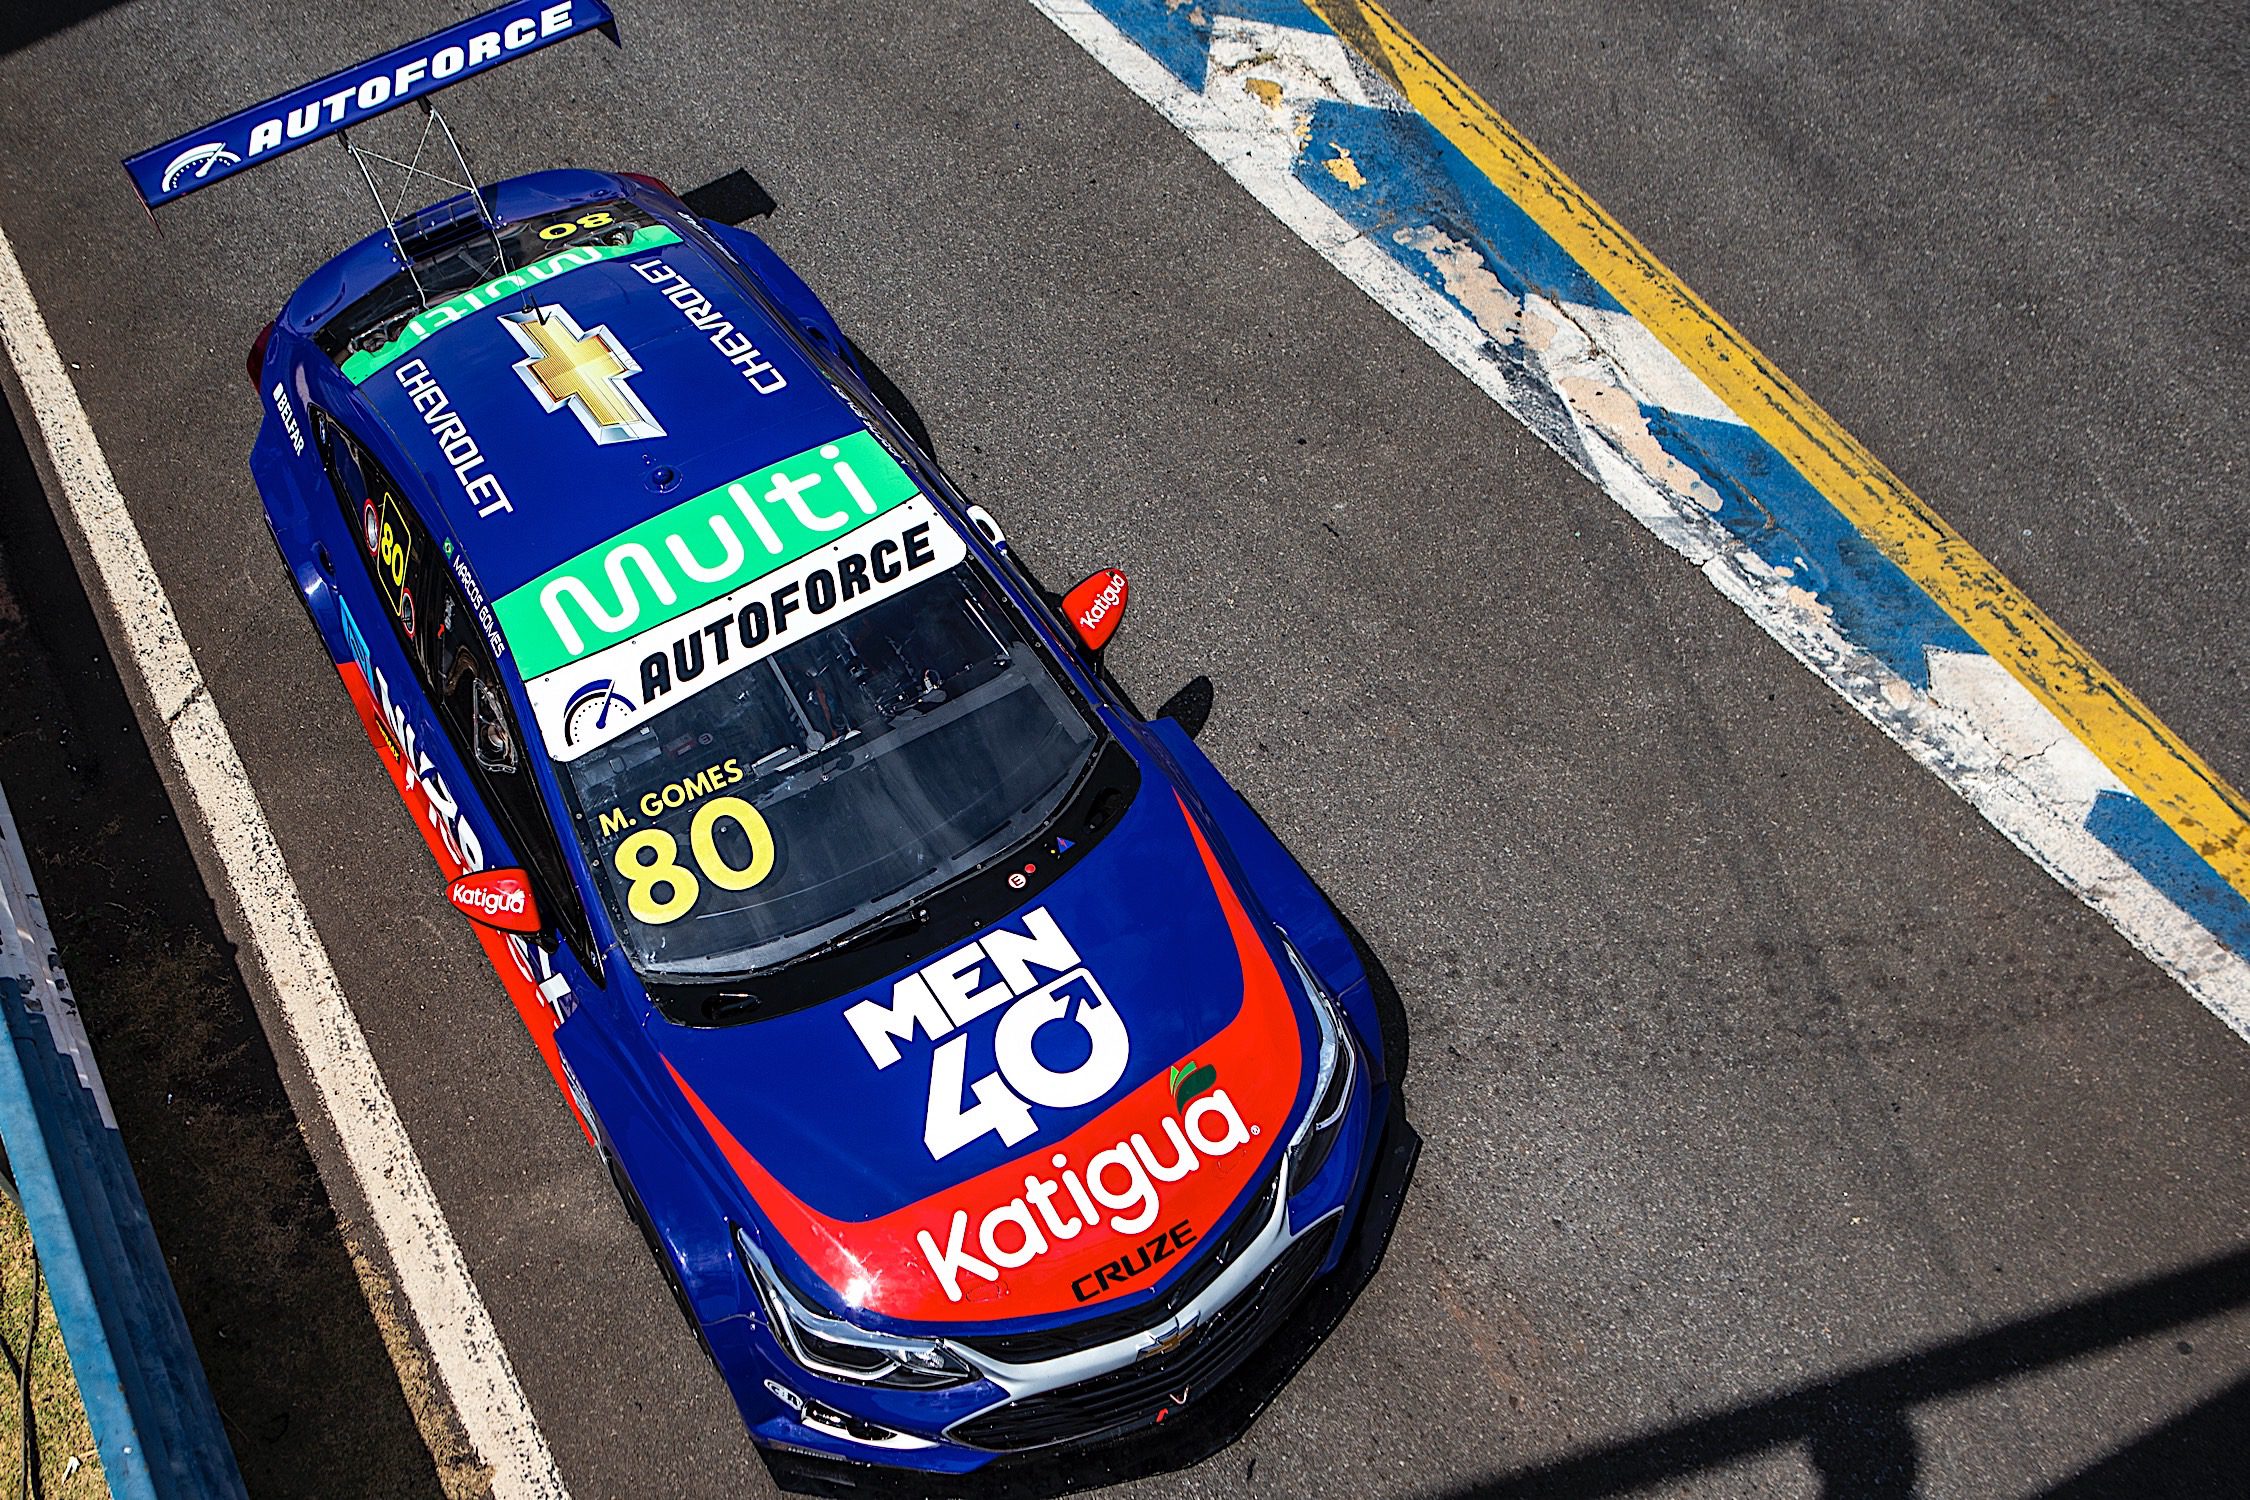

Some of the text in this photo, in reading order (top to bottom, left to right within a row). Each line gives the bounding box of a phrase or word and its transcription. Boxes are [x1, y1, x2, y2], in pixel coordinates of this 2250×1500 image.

[248, 0, 574, 158] AUTOFORCE
[539, 212, 613, 240] 80
[630, 259, 788, 395] CHEVROLET
[277, 392, 305, 457] BELFAR
[395, 358, 514, 518] CHEVROLET
[381, 522, 404, 587] 80
[453, 554, 506, 659] MARCOS GOMES
[640, 520, 937, 706] AUTOFORCE
[598, 758, 744, 838] M. GOMES
[614, 796, 775, 925] 80
[843, 906, 1082, 1070] MEN
[923, 967, 1130, 1161] 40
[1071, 1219, 1198, 1303] CRUZE
